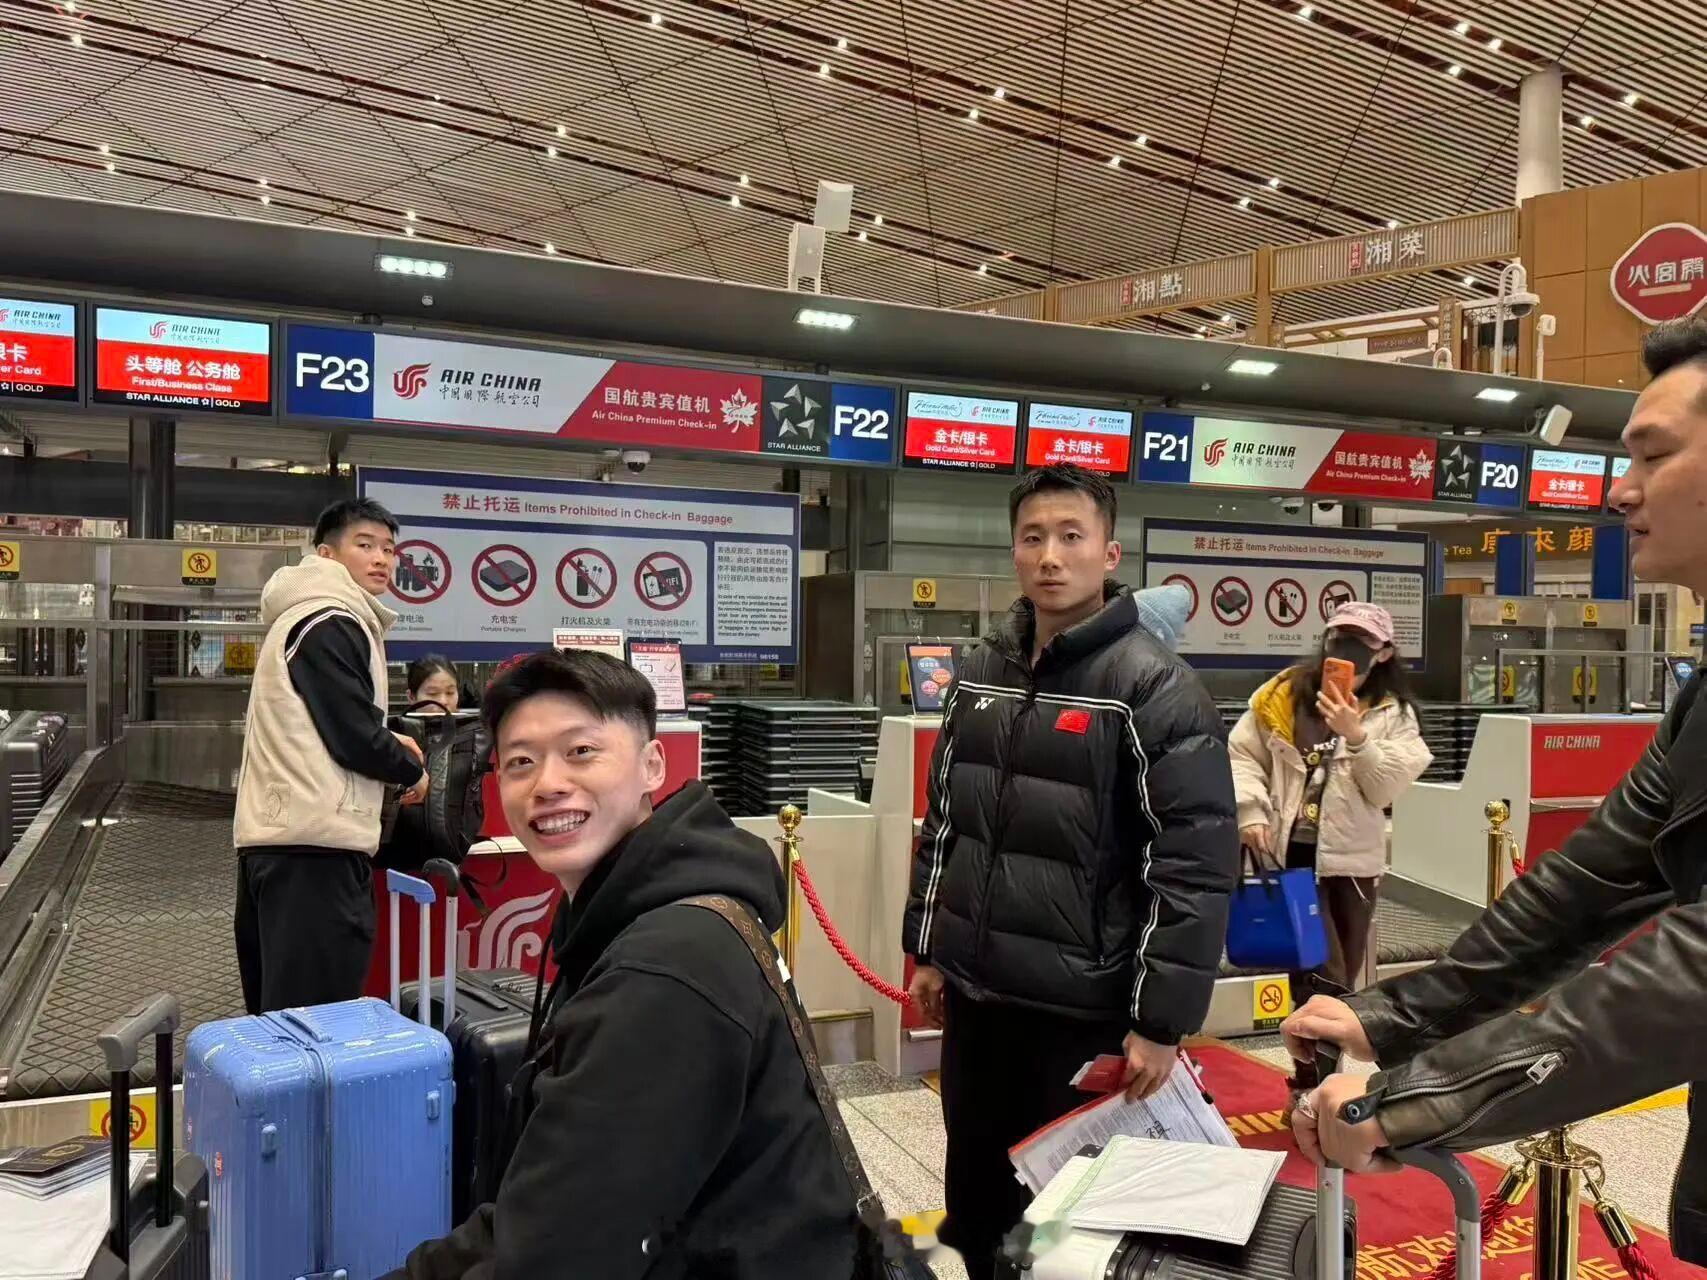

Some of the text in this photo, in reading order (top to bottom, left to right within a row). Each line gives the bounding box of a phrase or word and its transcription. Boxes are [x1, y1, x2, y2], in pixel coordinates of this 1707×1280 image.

[1367, 229, 1425, 264] 湘菜
[14, 310, 61, 320] AIR CHINA
[172, 324, 220, 336] AIR CHINA
[15, 366, 41, 375] Card
[126, 355, 240, 380] 头等舱 公务舱
[296, 352, 369, 393] F23
[16, 384, 43, 392] GOLD
[132, 377, 232, 393] First/Business Class
[441, 369, 541, 391] AIR CHINA
[126, 392, 240, 408] STAR ALLIANCE GOLD
[605, 387, 710, 414] 国航贵宾值机
[592, 411, 717, 430] Air China Premium Check-in
[834, 405, 889, 439] F22
[935, 429, 988, 446] 金卡/银卡
[768, 442, 820, 452] STAR ALLIANCE
[1054, 439, 1103, 454] 金卡/银卡
[1144, 432, 1188, 461] F21
[1234, 442, 1296, 457] AIR CHINA
[939, 459, 968, 467] ALLIANCE
[1334, 451, 1402, 470] 国航贵宾值机
[1353, 472, 1379, 480] Premium
[1482, 462, 1518, 488] F20
[442, 493, 732, 526] 禁止托运 Items Prohibited in Check-in Baggage
[1194, 537, 1244, 551] 禁止托运
[1246, 544, 1267, 552] Items
[1269, 544, 1308, 553] Prohibited
[1353, 548, 1384, 558] Baggage
[1454, 544, 1472, 555] Tea
[491, 615, 518, 624] 充电宝
[561, 616, 611, 625] 打火机及火柴
[1544, 736, 1600, 748] AIR CHINA
